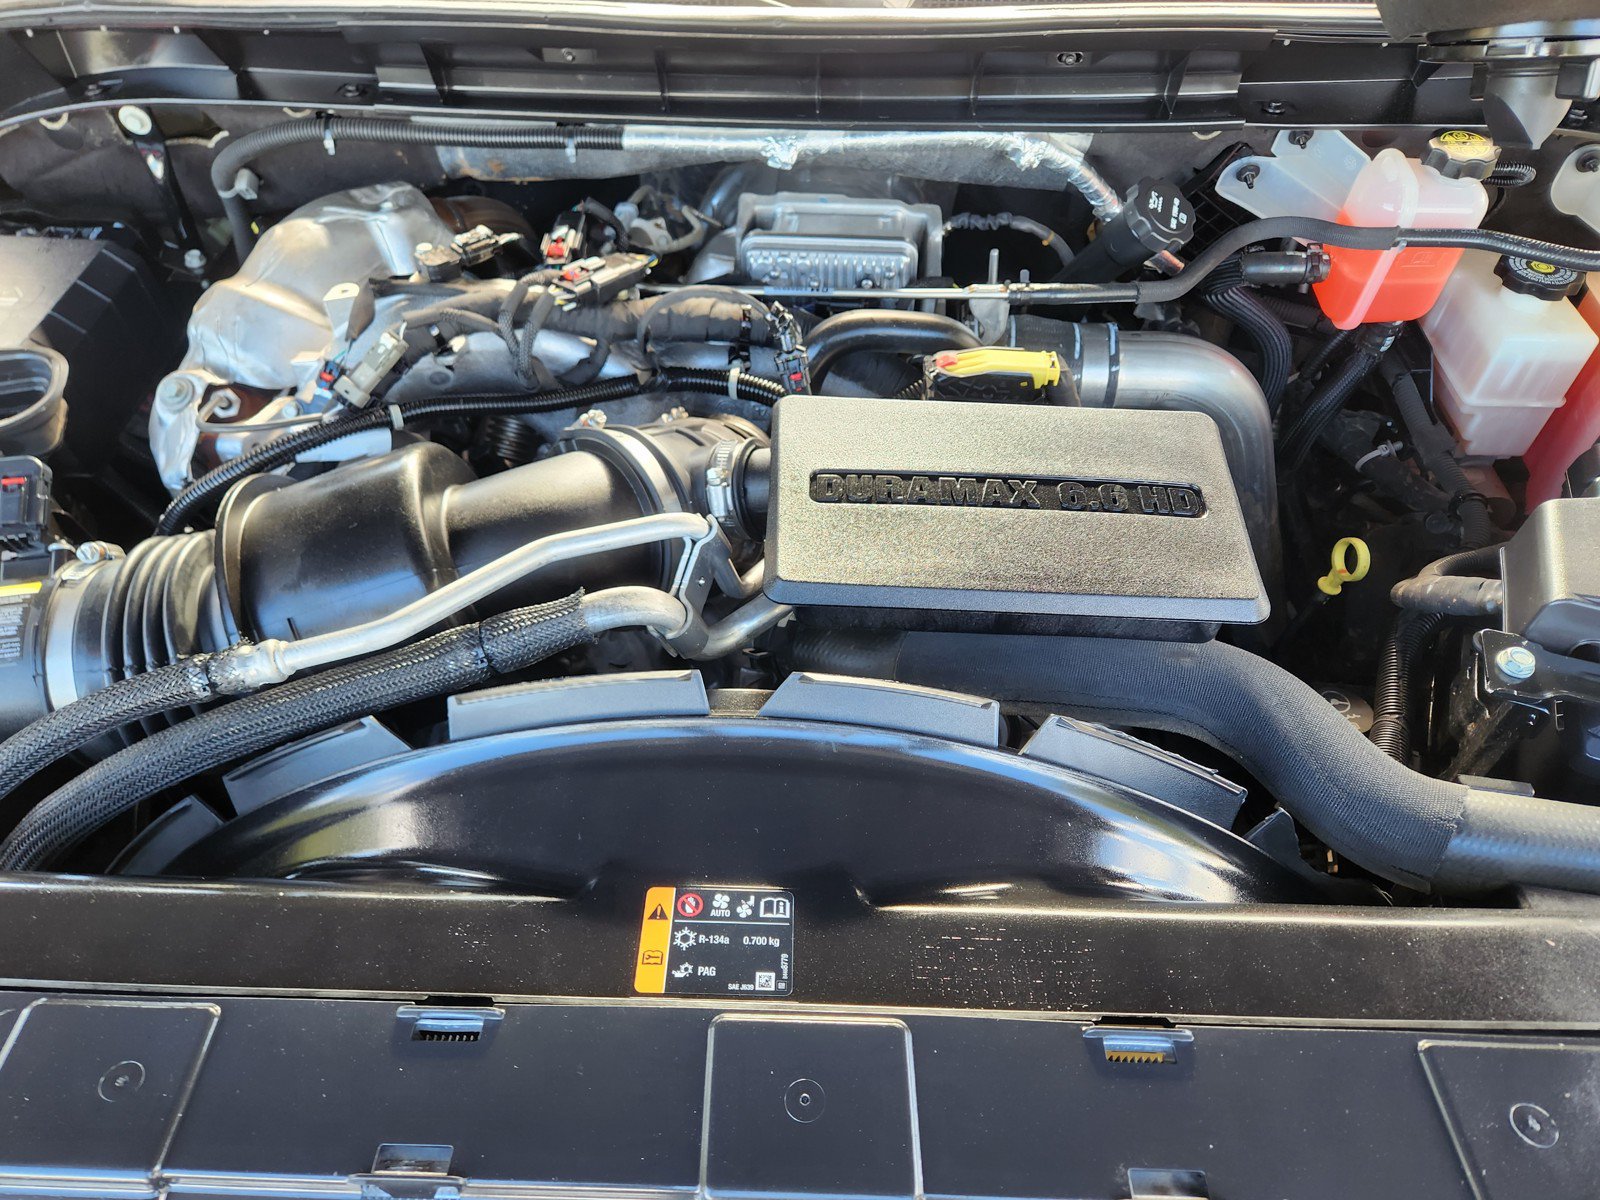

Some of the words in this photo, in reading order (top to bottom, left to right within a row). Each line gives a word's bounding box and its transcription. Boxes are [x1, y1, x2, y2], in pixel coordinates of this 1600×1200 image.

[816, 474, 1040, 508] DURAMAX
[1056, 481, 1129, 512] 6.6
[1137, 485, 1200, 516] HD
[710, 909, 731, 917] AUTO
[698, 935, 730, 945] R-134a
[742, 936, 767, 946] 0.700
[768, 936, 780, 947] kg
[697, 966, 717, 976] PAG
[727, 983, 740, 991] SAE
